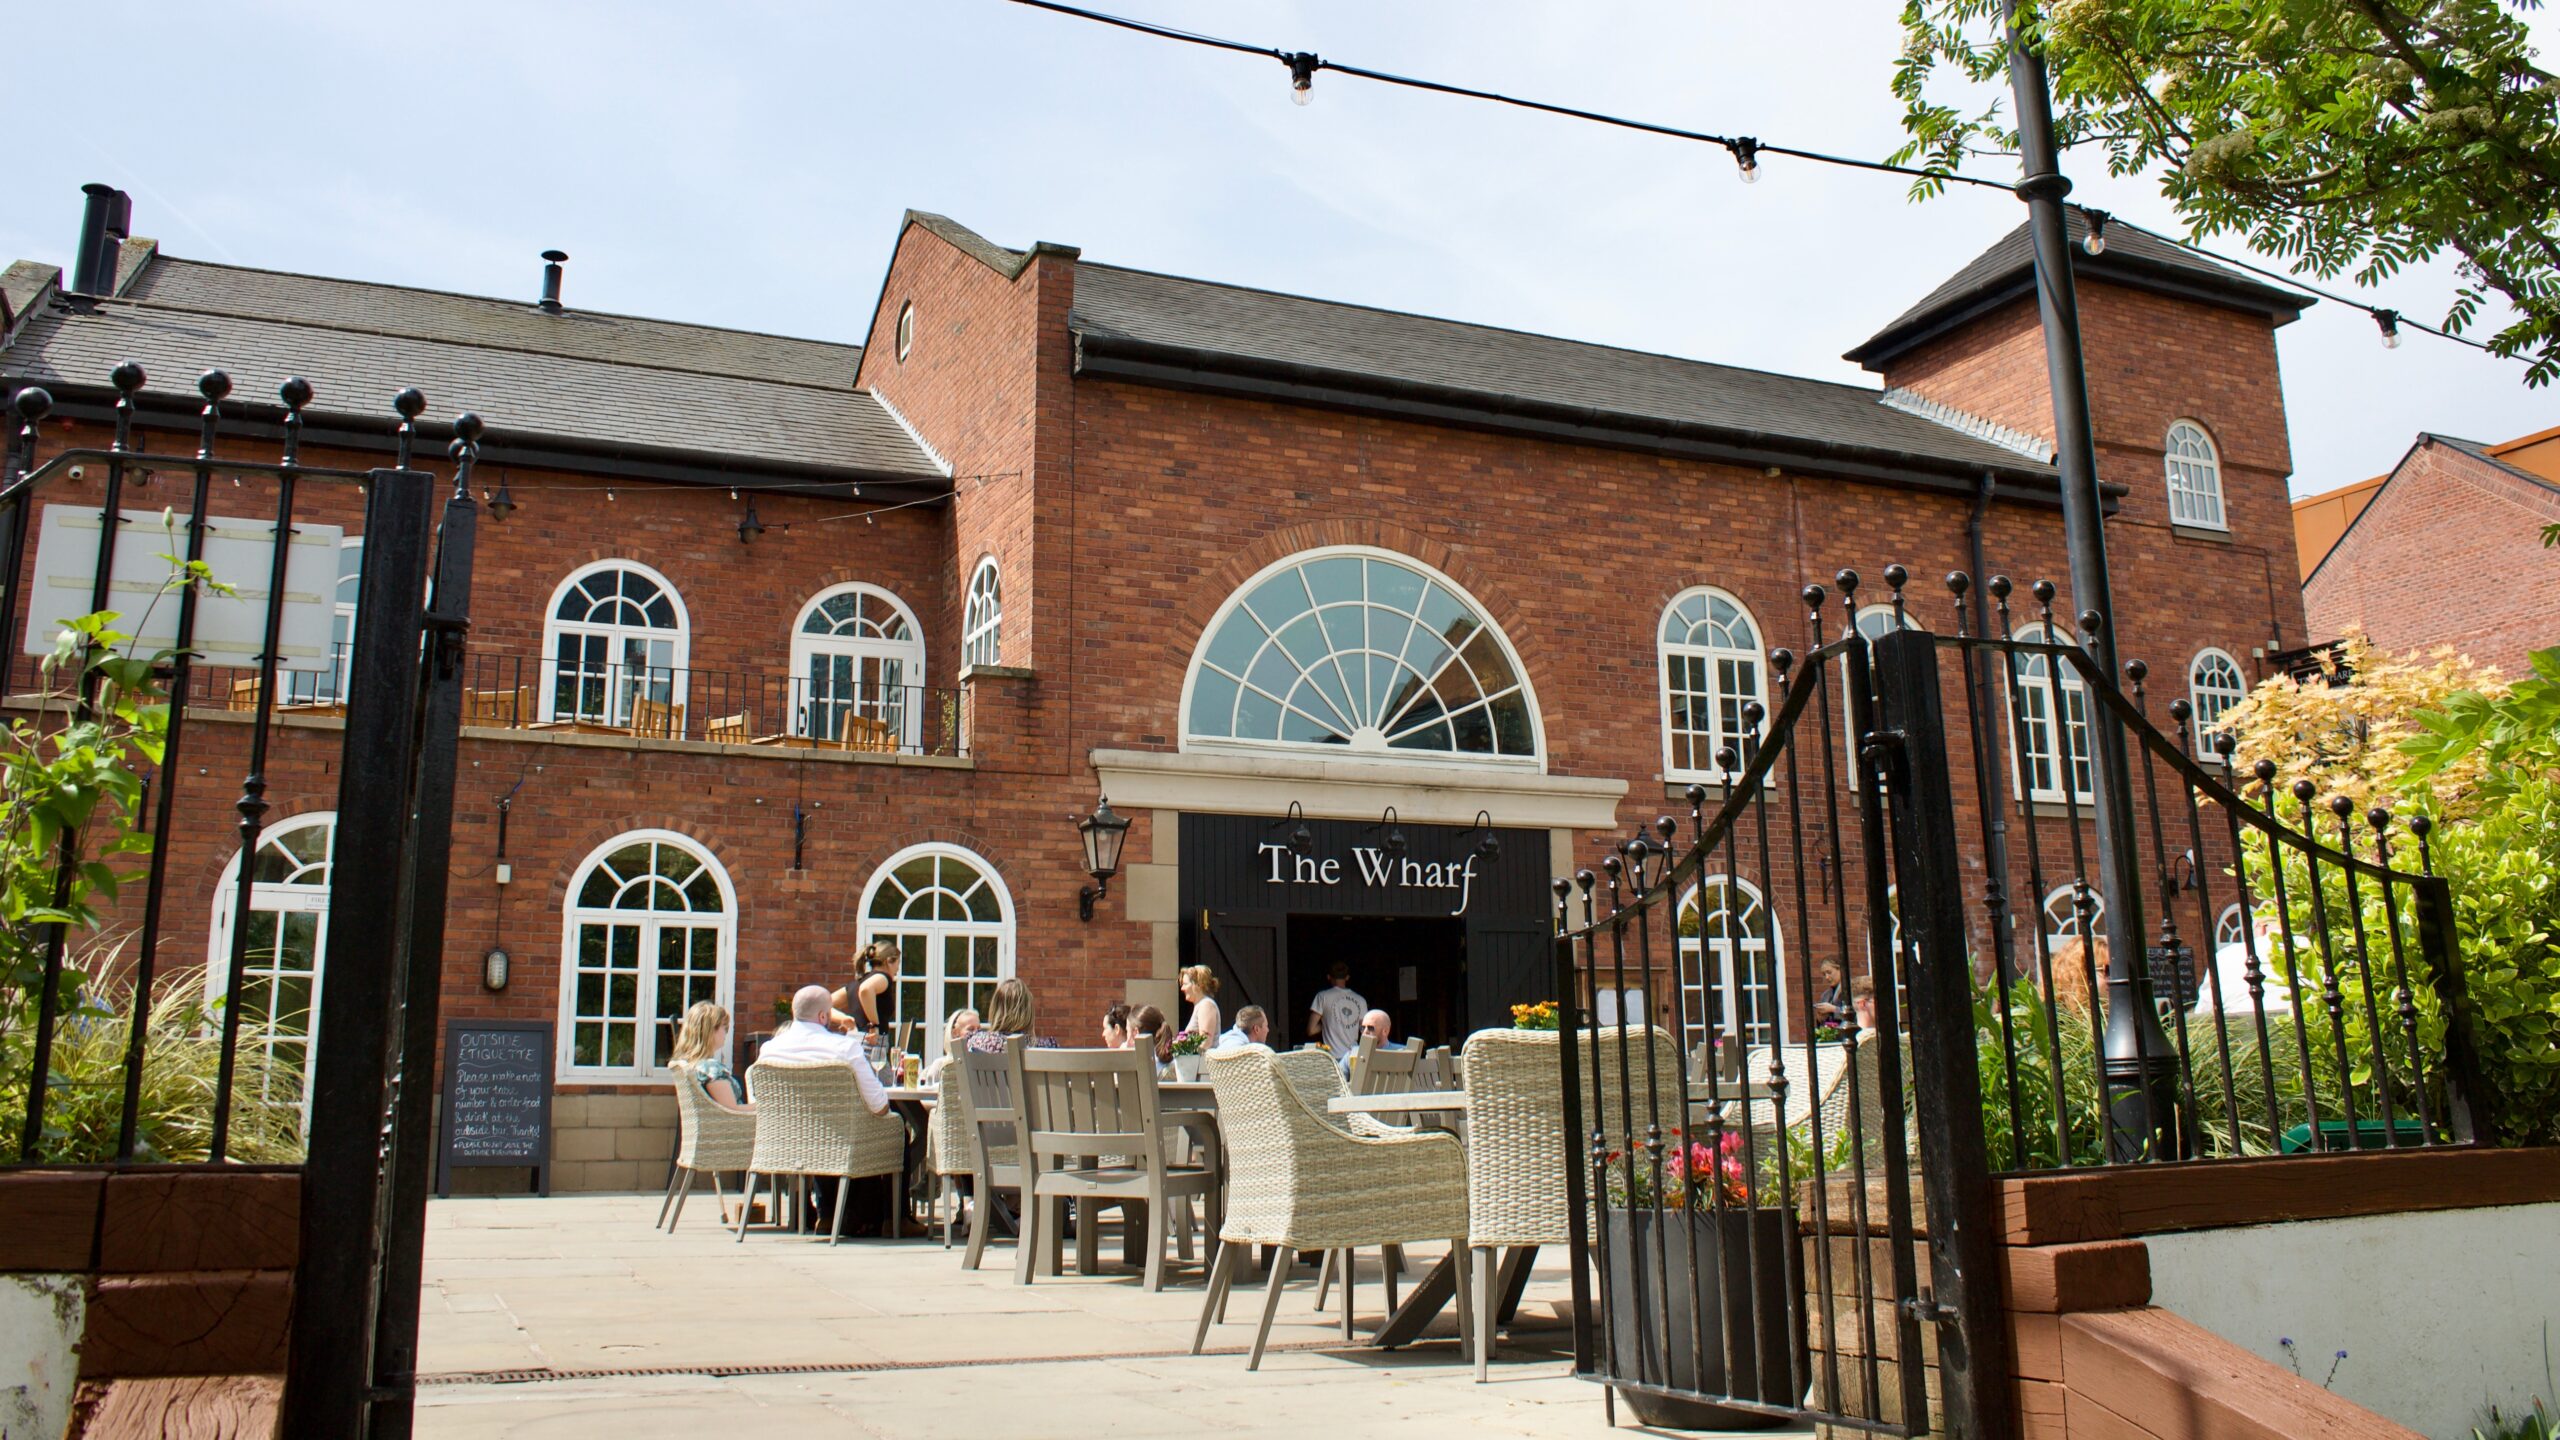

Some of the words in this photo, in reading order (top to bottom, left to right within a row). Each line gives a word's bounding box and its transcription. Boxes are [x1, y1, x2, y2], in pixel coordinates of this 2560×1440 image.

[1258, 842, 1341, 884] The
[1352, 846, 1478, 917] Wharf
[460, 1033, 521, 1047] OUTSIDE
[459, 1048, 537, 1061] ETIQUETTE
[457, 1069, 490, 1083] Please
[455, 1083, 468, 1100] of
[469, 1087, 490, 1100] your
[455, 1099, 487, 1108] number
[490, 1097, 497, 1108] &
[499, 1097, 521, 1108] order
[455, 1111, 462, 1123] &
[464, 1111, 488, 1123] drink
[491, 1112, 502, 1122] at
[455, 1124, 490, 1136] outside
[511, 1123, 540, 1138] Thanks!
